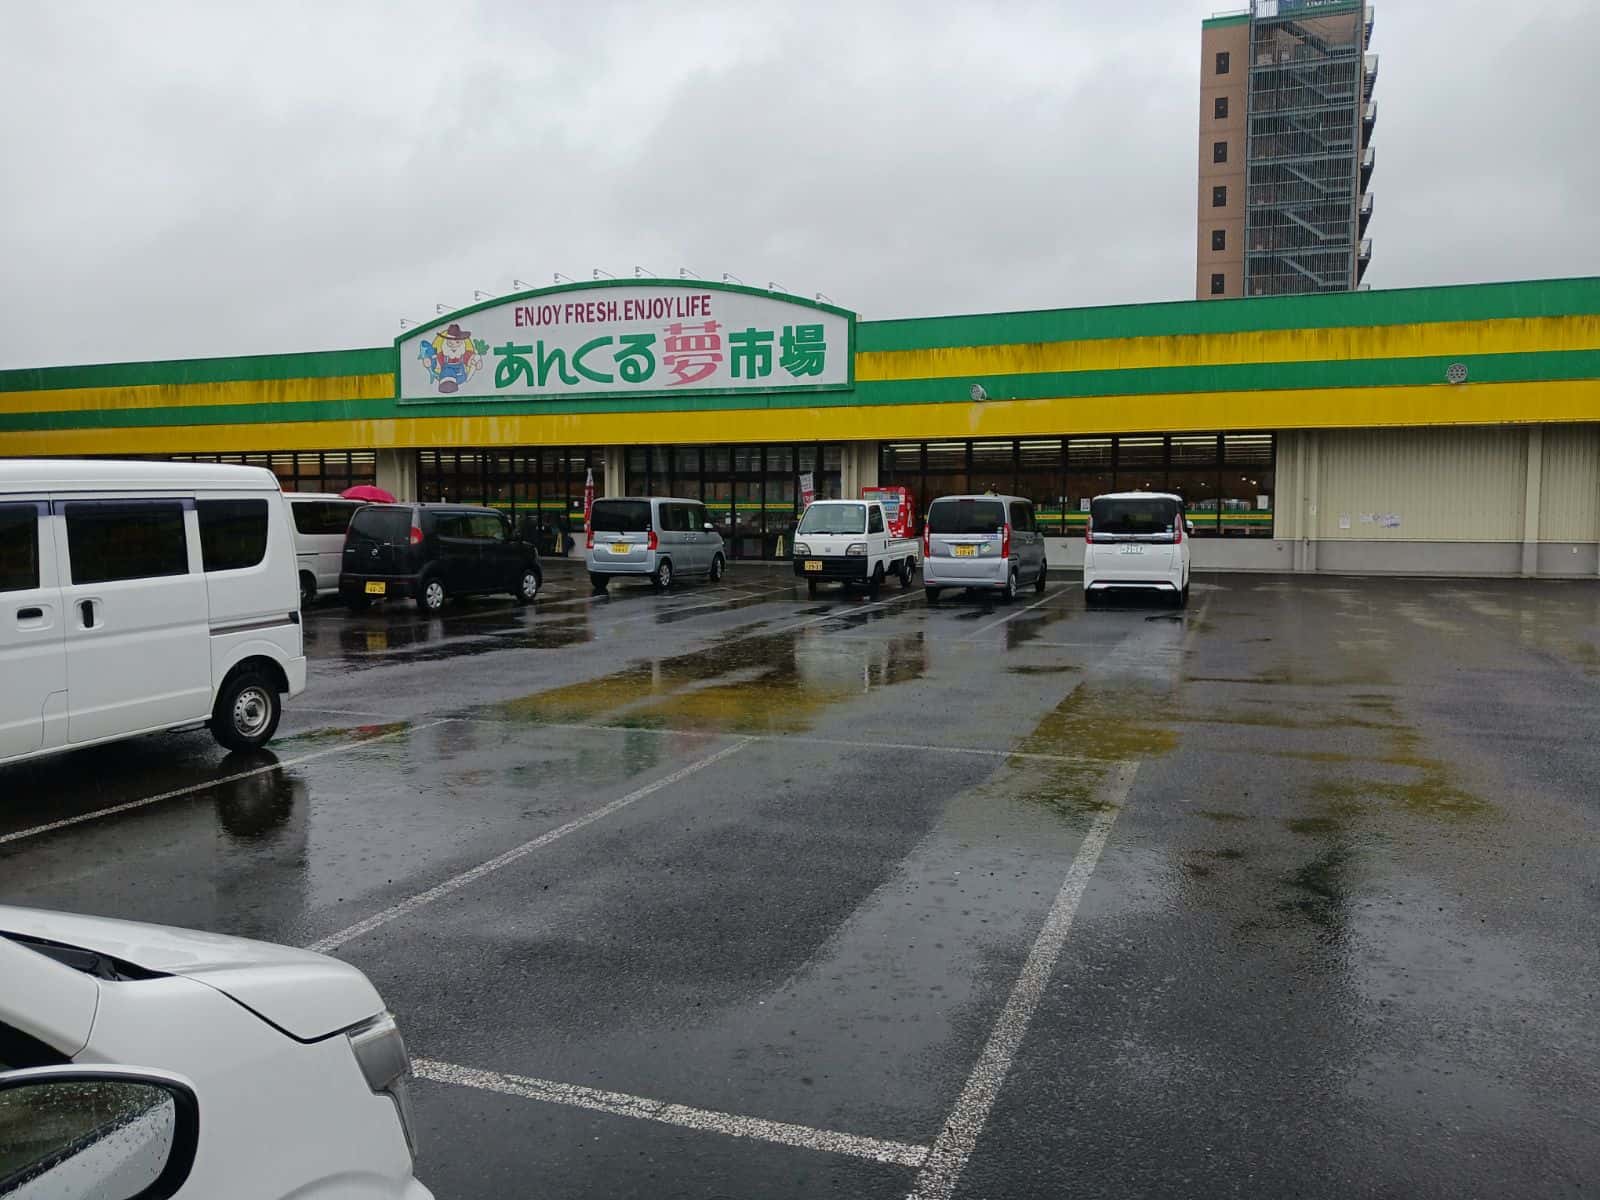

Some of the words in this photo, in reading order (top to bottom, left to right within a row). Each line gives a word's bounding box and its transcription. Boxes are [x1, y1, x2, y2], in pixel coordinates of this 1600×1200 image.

[515, 303, 562, 327] ENJOY
[676, 295, 712, 318] LIFE
[492, 319, 827, 389] あんくる夢市場
